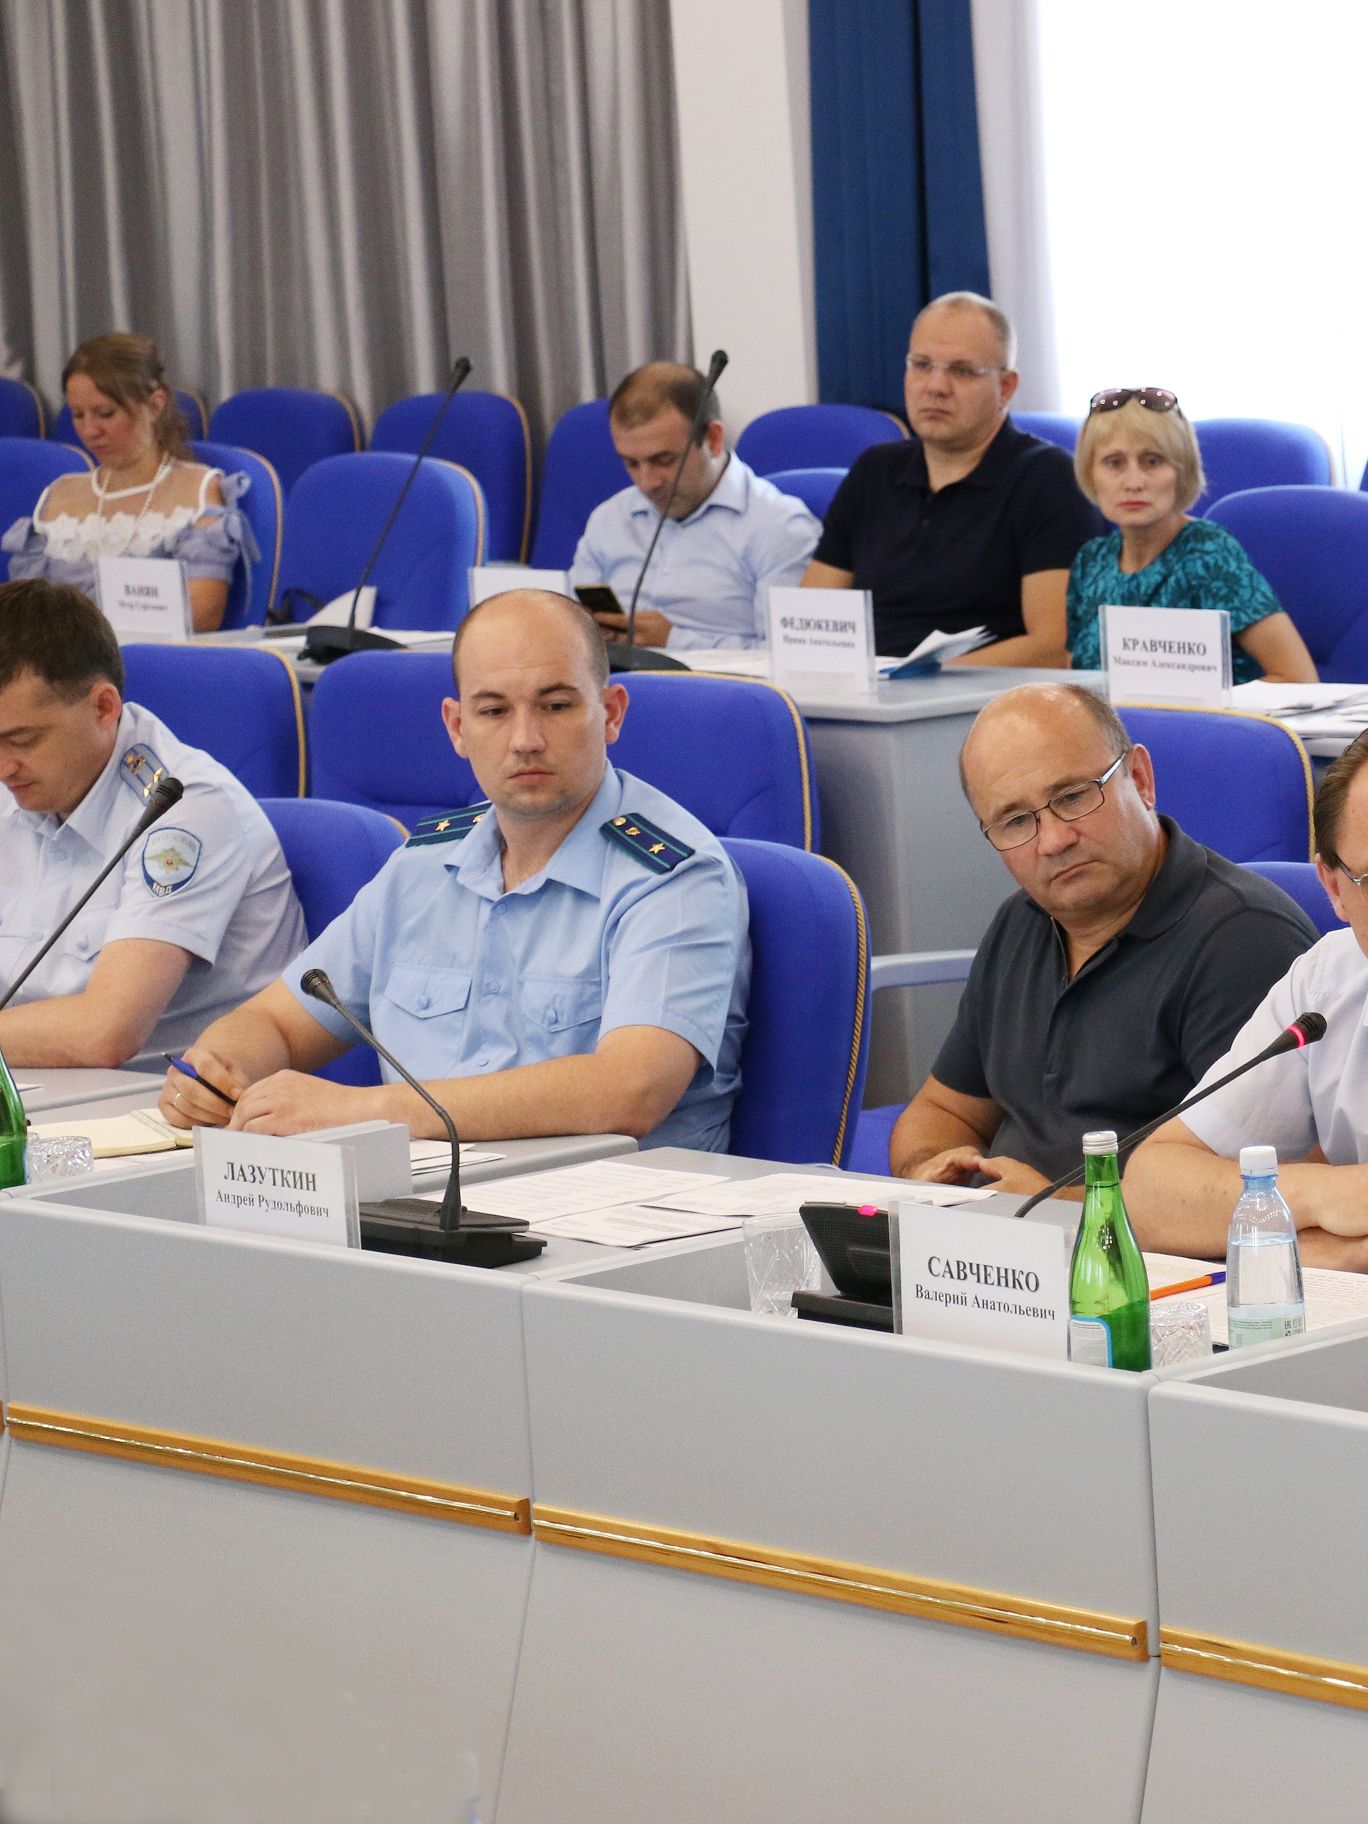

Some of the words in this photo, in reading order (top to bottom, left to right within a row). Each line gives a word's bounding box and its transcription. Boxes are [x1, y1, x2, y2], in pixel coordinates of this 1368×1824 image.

[780, 616, 856, 633] ФЕДЮКЕВИЧ
[1122, 638, 1207, 656] КРАВЧЕНКО
[1113, 656, 1148, 668] Максим
[1151, 659, 1217, 673] Александрович
[153, 882, 171, 897] МВД
[224, 1162, 317, 1192] ЛАЗУТКИН
[215, 1190, 255, 1209] Андрей
[258, 1196, 329, 1218] Рудольфович
[928, 1256, 1040, 1293] САВЧЕНКО
[915, 1284, 967, 1307] Валерий
[971, 1294, 1056, 1321] Анатольевич
